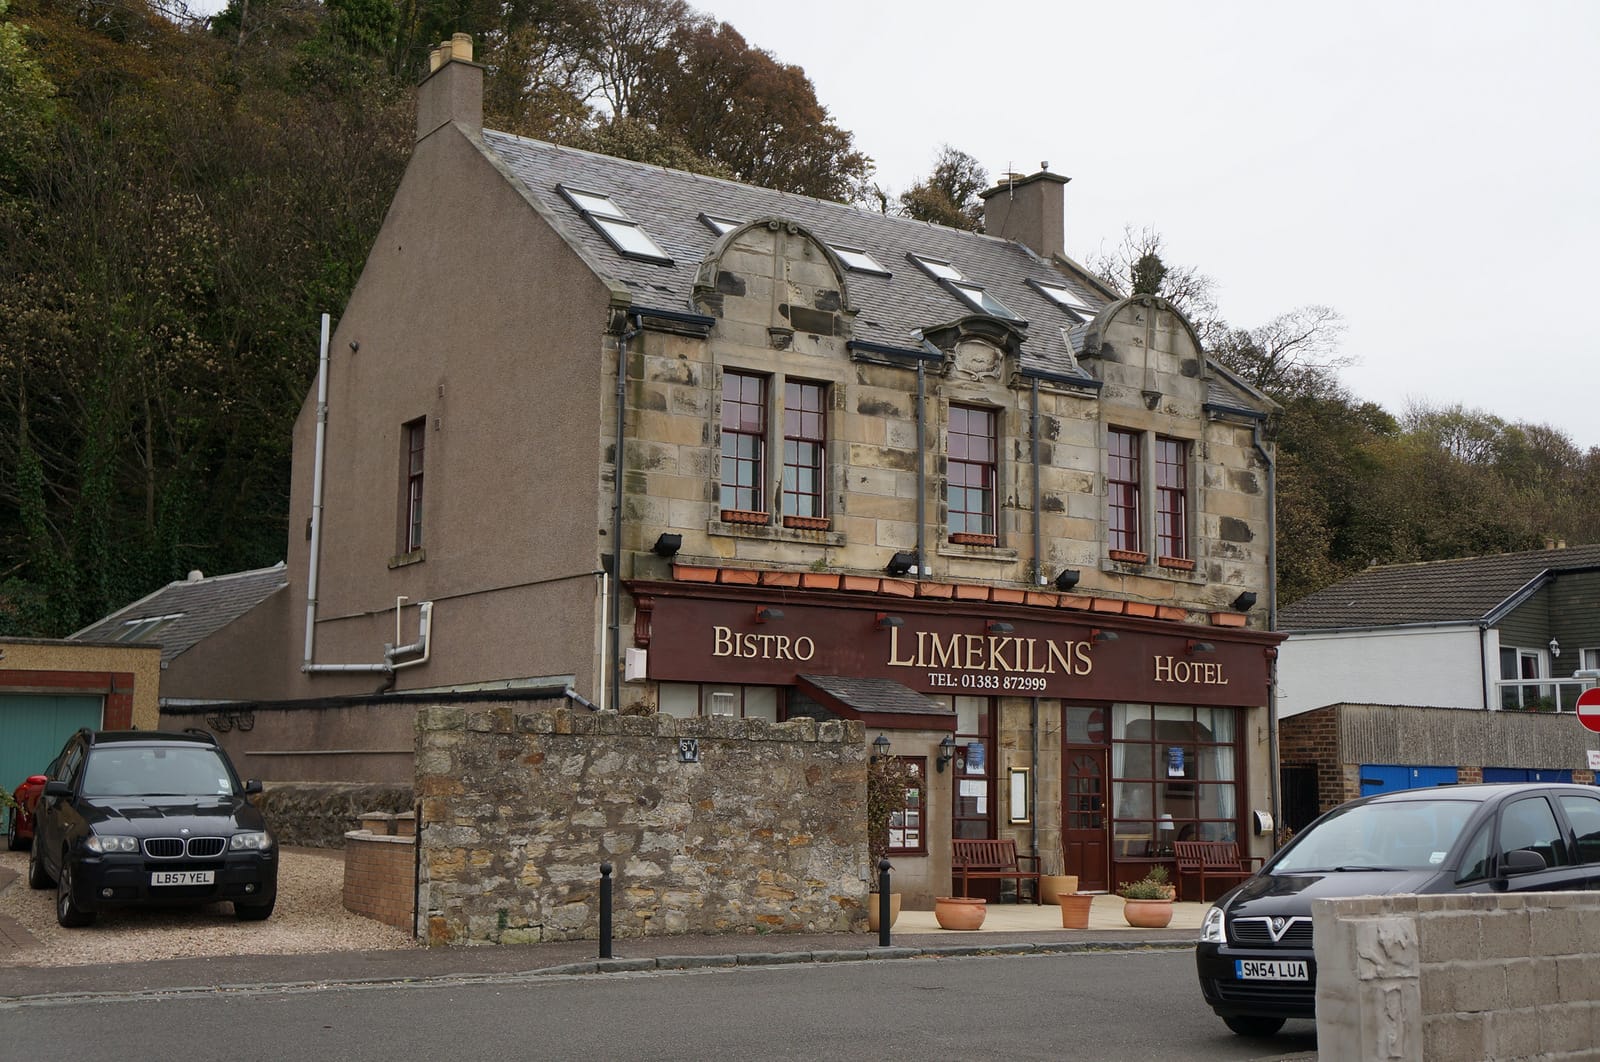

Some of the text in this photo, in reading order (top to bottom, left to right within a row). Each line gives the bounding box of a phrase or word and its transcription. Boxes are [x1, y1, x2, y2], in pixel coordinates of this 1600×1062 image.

[712, 626, 815, 660] BISTRO
[887, 626, 1093, 675] LIMEKILNS
[1154, 655, 1228, 684] HOTEL
[928, 673, 1047, 691] TEL: 01383 872999
[157, 873, 210, 884] LB57 YEL
[1243, 962, 1306, 978] SN54 LUA
